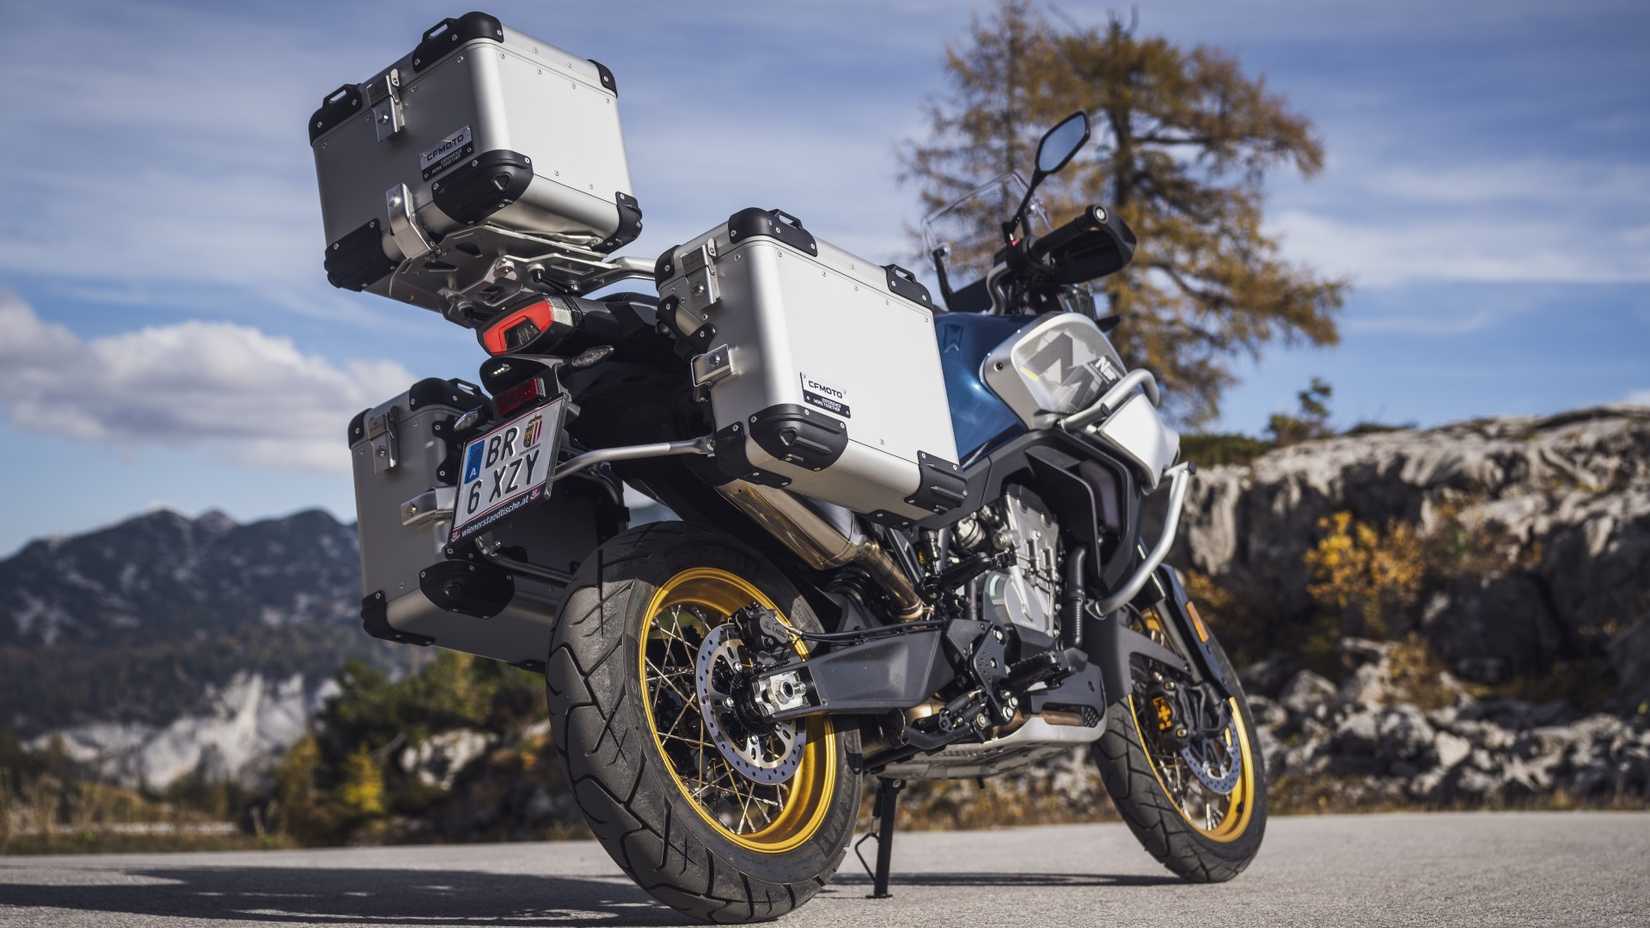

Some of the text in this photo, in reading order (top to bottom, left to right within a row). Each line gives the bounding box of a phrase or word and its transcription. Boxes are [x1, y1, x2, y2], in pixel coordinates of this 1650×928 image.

[427, 134, 464, 161] CFMOTO
[808, 380, 843, 399] CFMOTO
[485, 427, 519, 469] BR
[467, 449, 540, 515] 6 XZY
[469, 467, 477, 479] A
